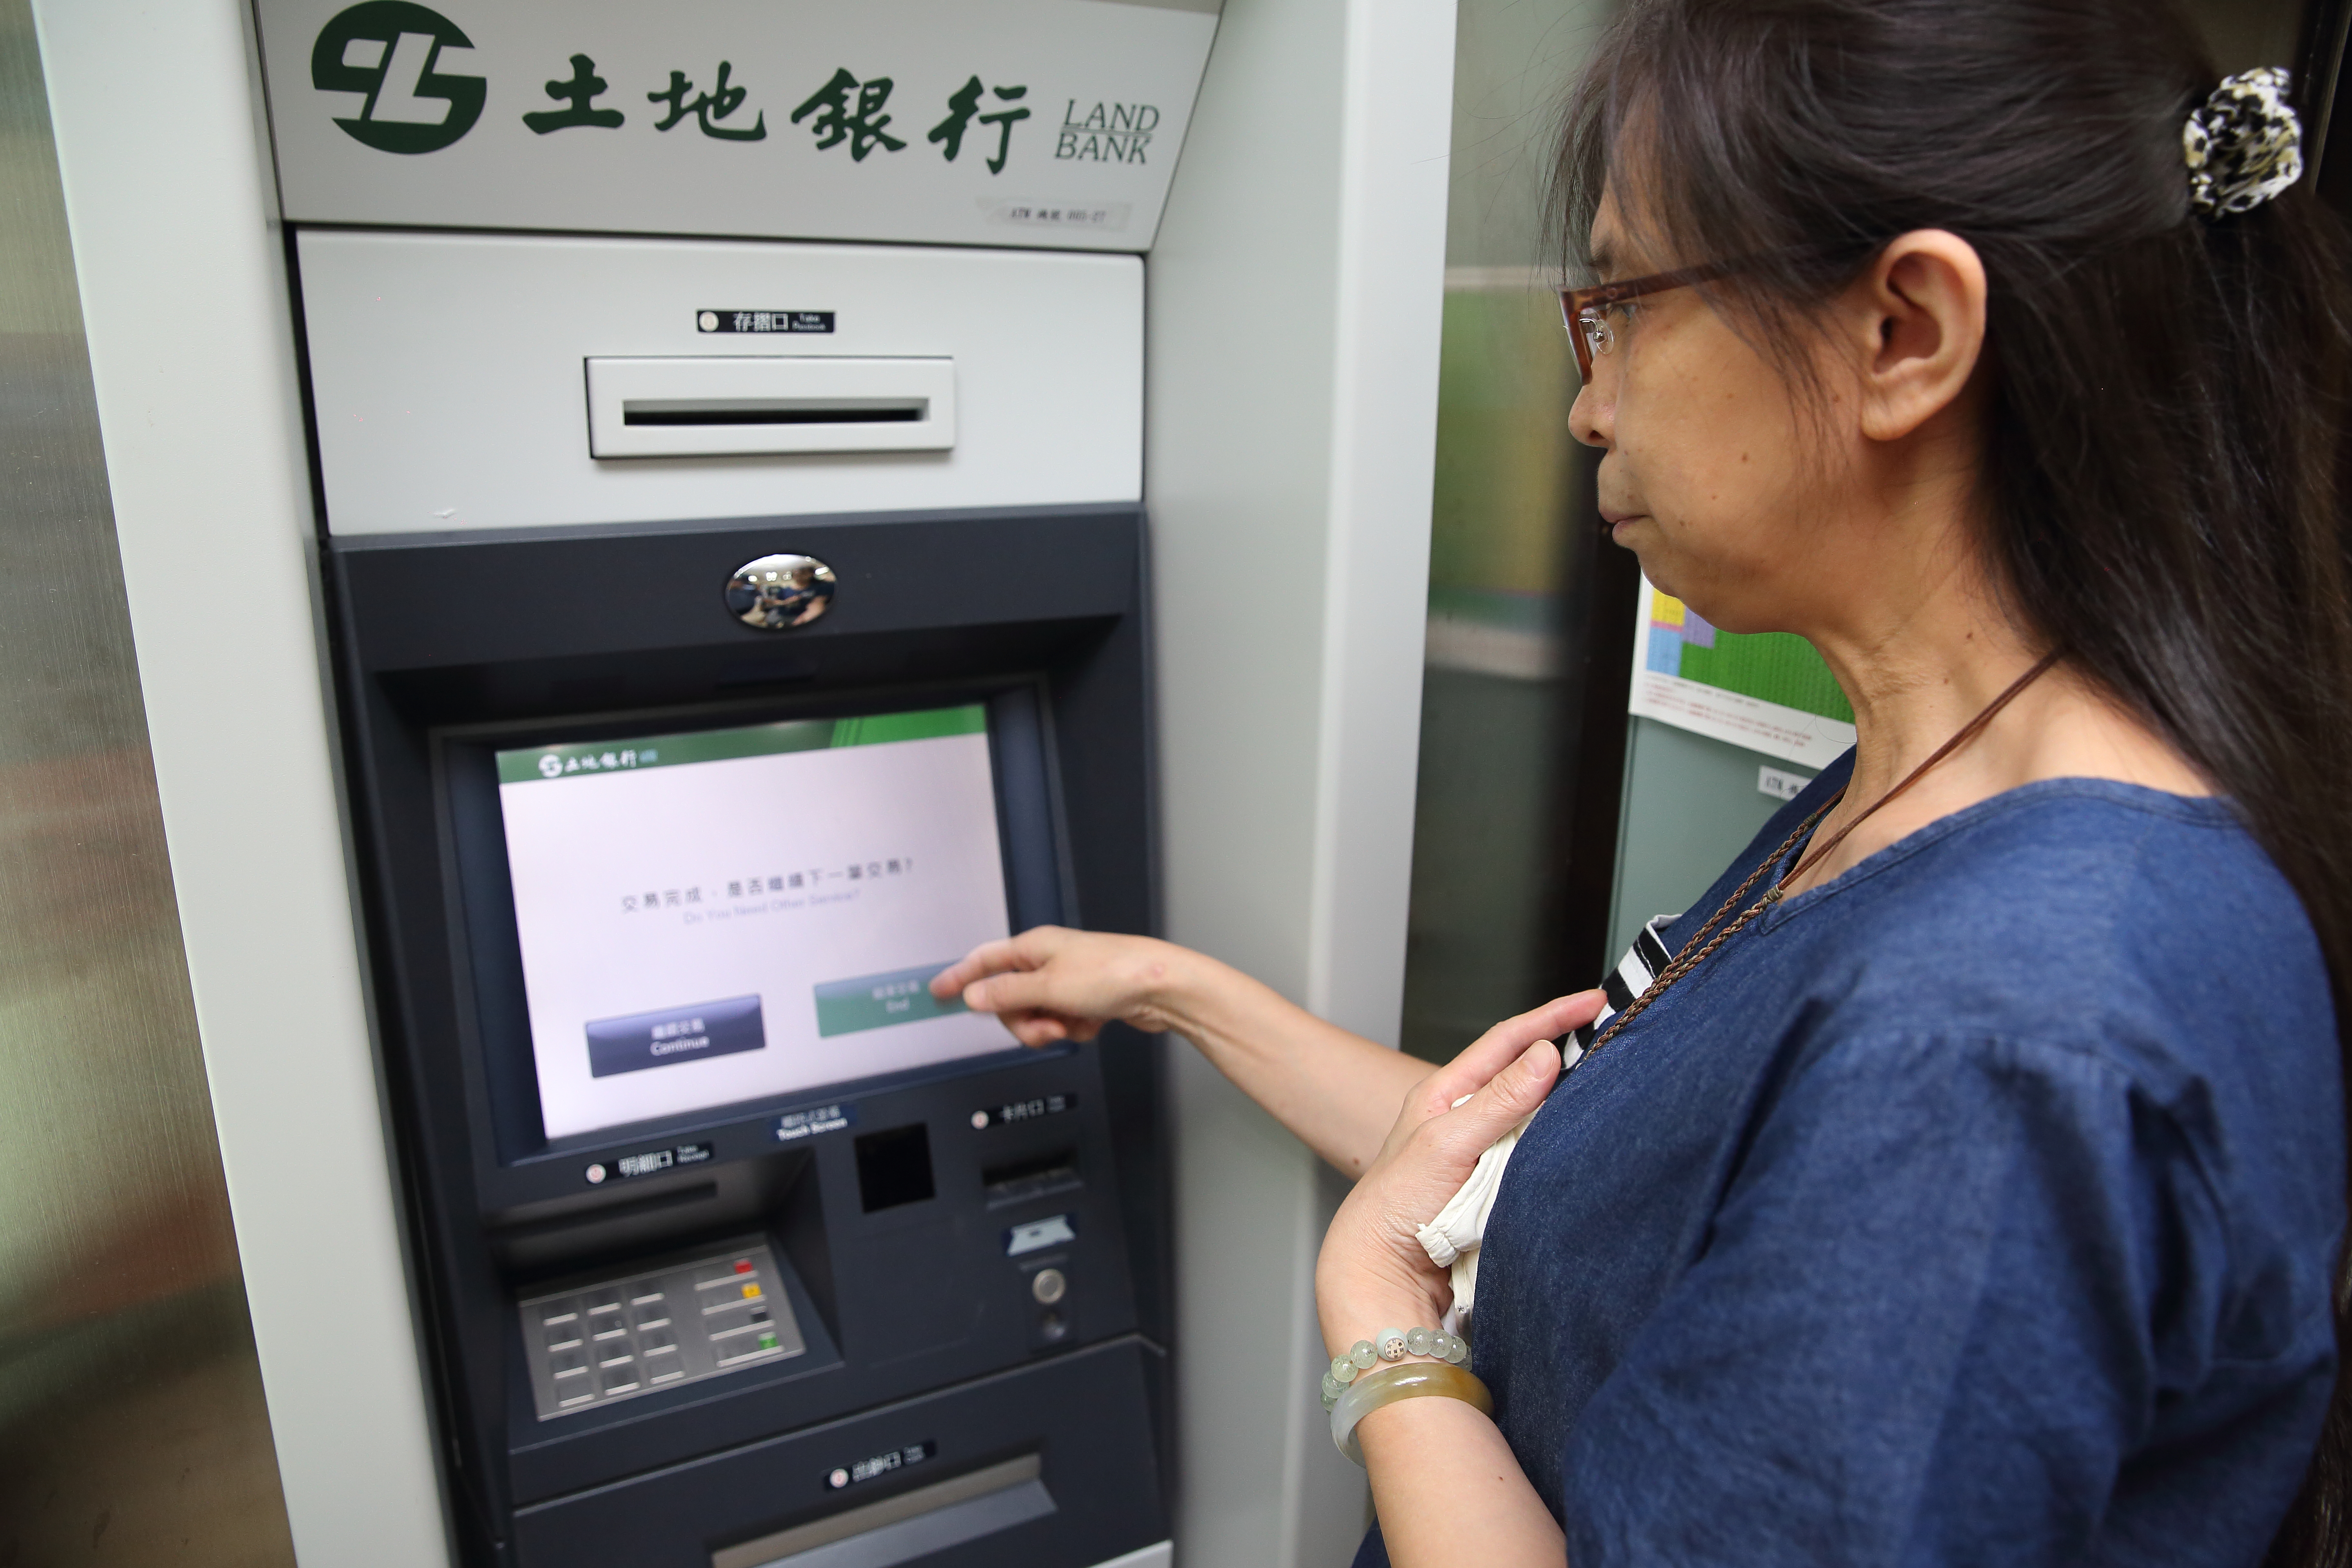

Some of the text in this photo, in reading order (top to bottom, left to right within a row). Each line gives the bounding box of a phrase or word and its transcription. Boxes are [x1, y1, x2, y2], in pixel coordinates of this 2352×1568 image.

[522, 53, 1030, 174] 土地銀行
[1063, 99, 1160, 131] LAND
[1055, 132, 1152, 164] BANK
[650, 1036, 710, 1056] Continue
